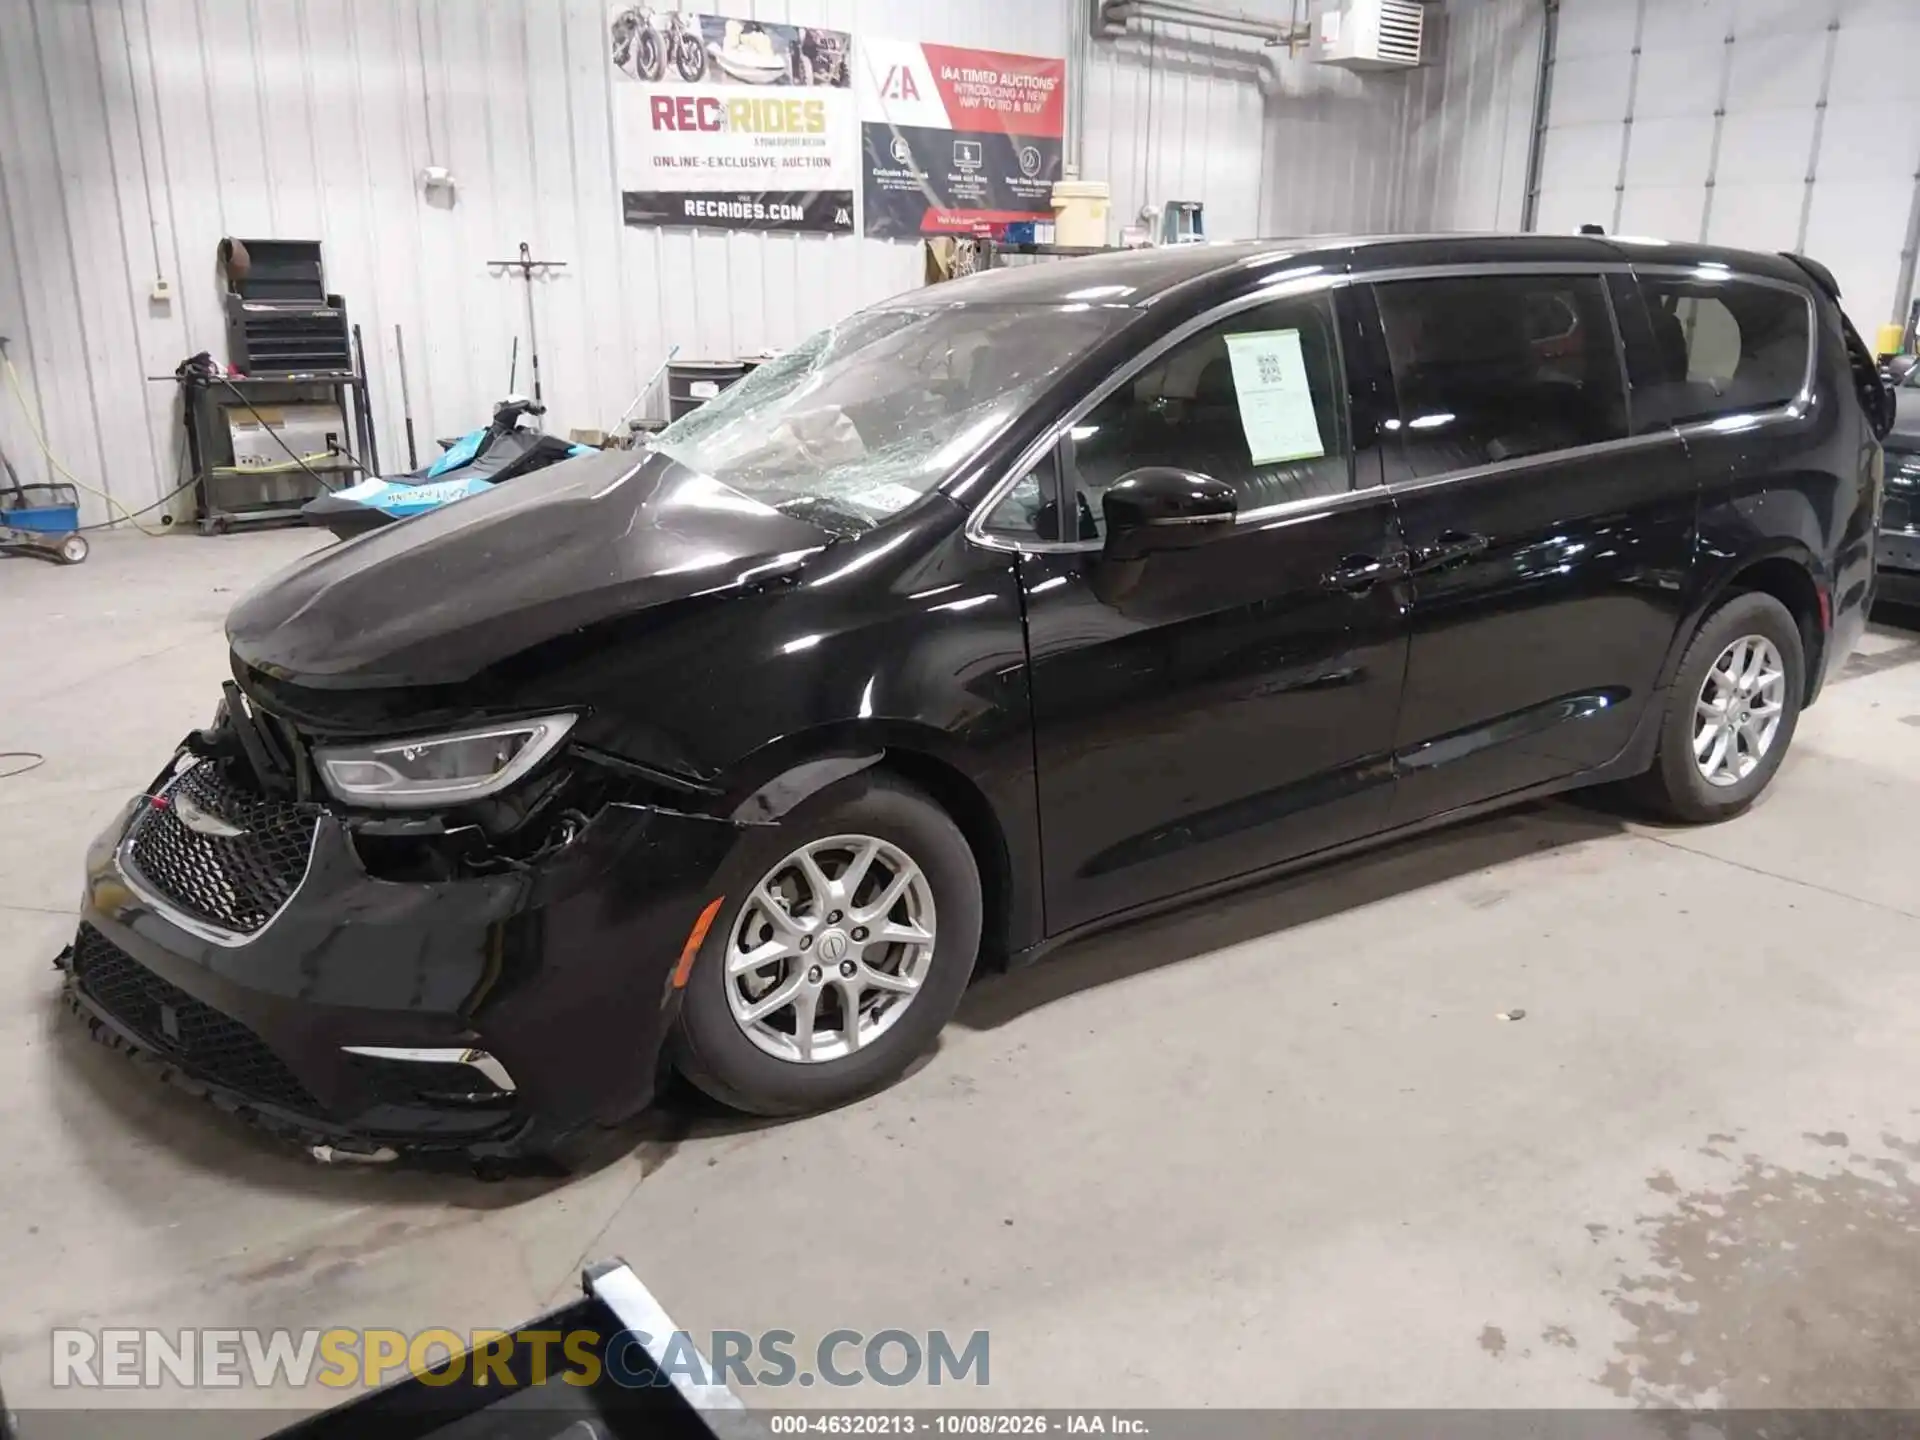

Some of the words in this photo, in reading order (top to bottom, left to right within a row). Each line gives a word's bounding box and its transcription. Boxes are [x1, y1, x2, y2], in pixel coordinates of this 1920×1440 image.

[941, 66, 960, 81] IAA
[962, 69, 997, 85] TIMED
[650, 95, 720, 132] REC
[728, 98, 826, 133] RIDES
[959, 96, 980, 109] WAY
[983, 97, 997, 109] TO
[1023, 102, 1043, 114] BUY
[653, 156, 777, 168] ONLINE-EXCLUSIVE
[782, 156, 832, 168] AUCTION
[684, 199, 804, 221] RECRIDES.COM
